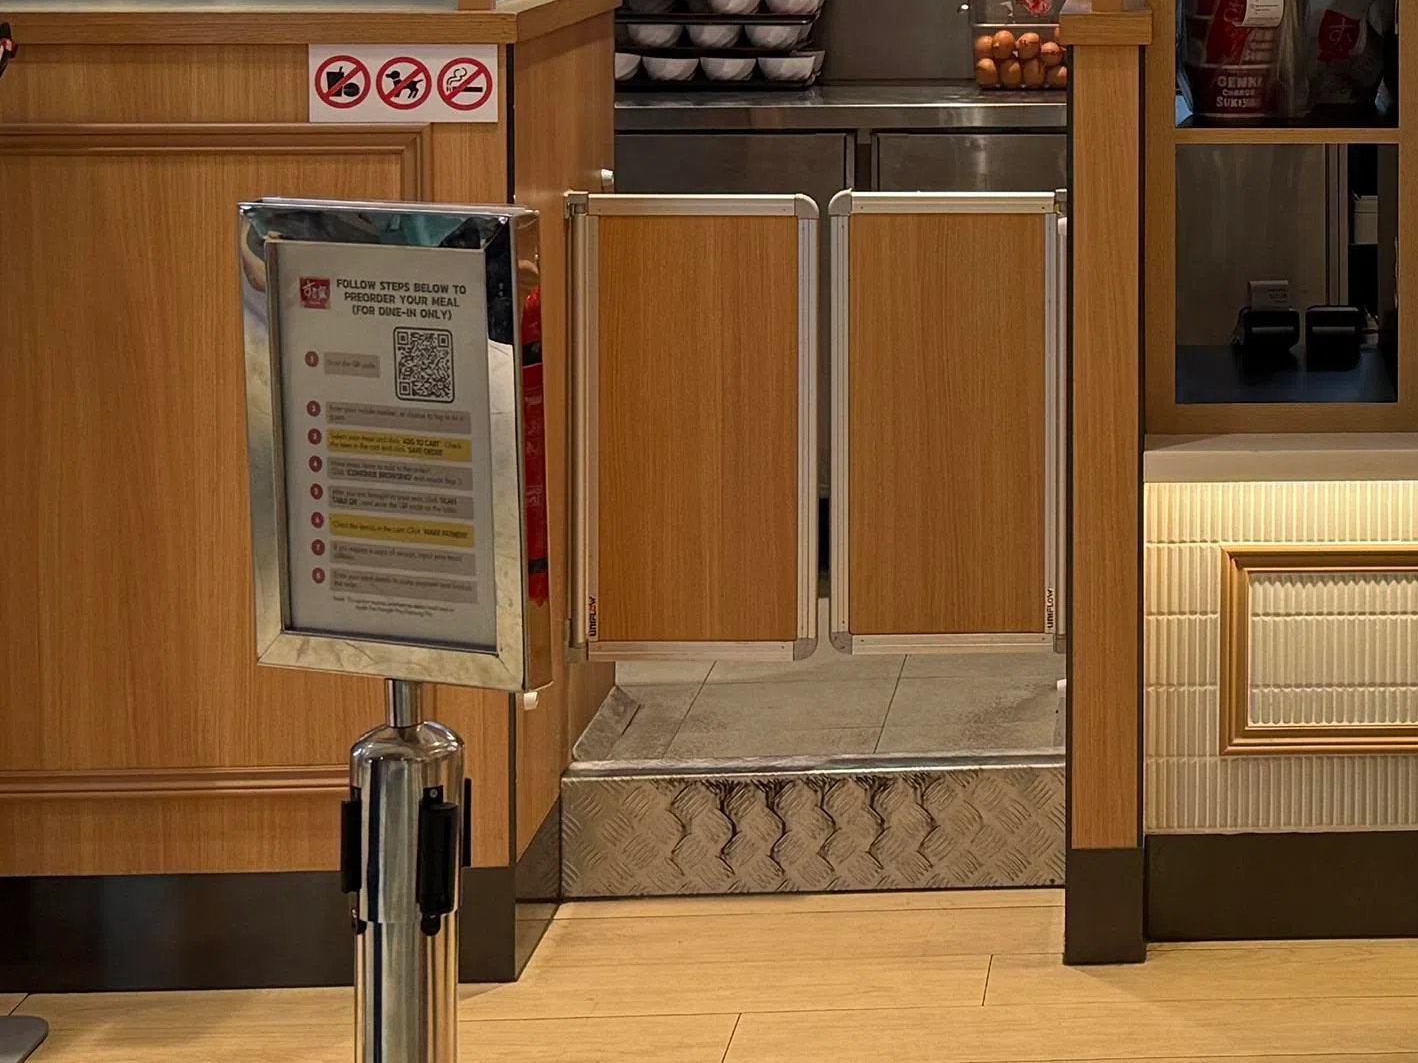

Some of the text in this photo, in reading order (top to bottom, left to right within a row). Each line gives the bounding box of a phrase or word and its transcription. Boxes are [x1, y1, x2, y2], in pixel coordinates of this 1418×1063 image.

[336, 278, 467, 296] FOLLOW STEPS BELOW TO
[344, 292, 460, 308] PREORDER YOUR MEAL
[352, 305, 453, 321] (FOR DINE-IN ONLY)
